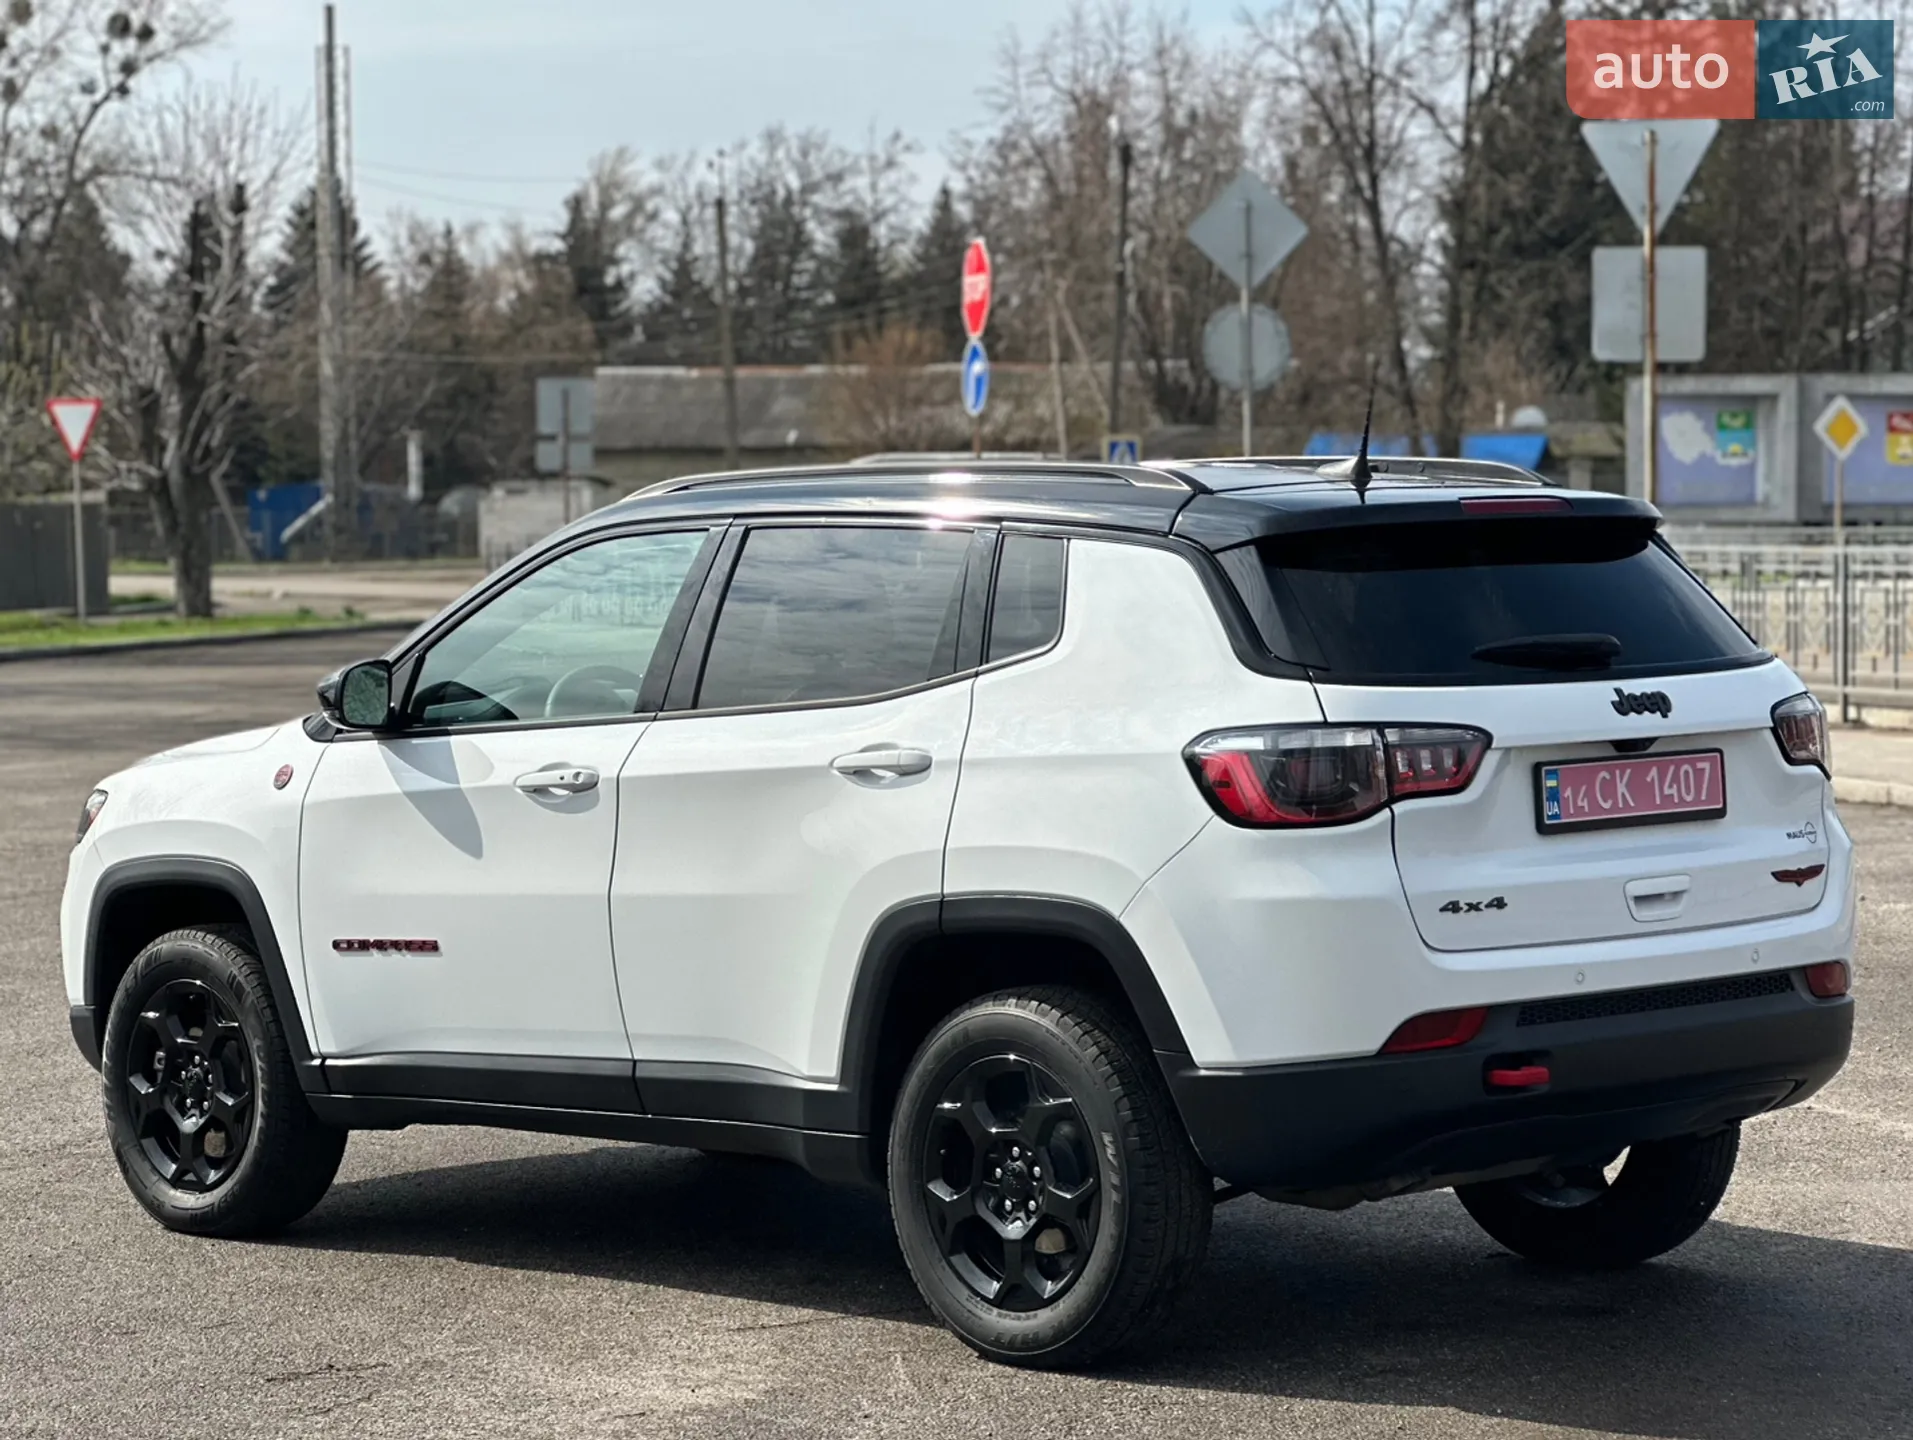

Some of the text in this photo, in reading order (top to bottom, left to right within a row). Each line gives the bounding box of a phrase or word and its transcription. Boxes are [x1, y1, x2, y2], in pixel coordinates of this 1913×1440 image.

[1611, 687, 1672, 719] Jeep
[1564, 761, 1711, 814] 14 CK 1407
[1546, 801, 1560, 815] UA
[1438, 896, 1508, 914] 4x4
